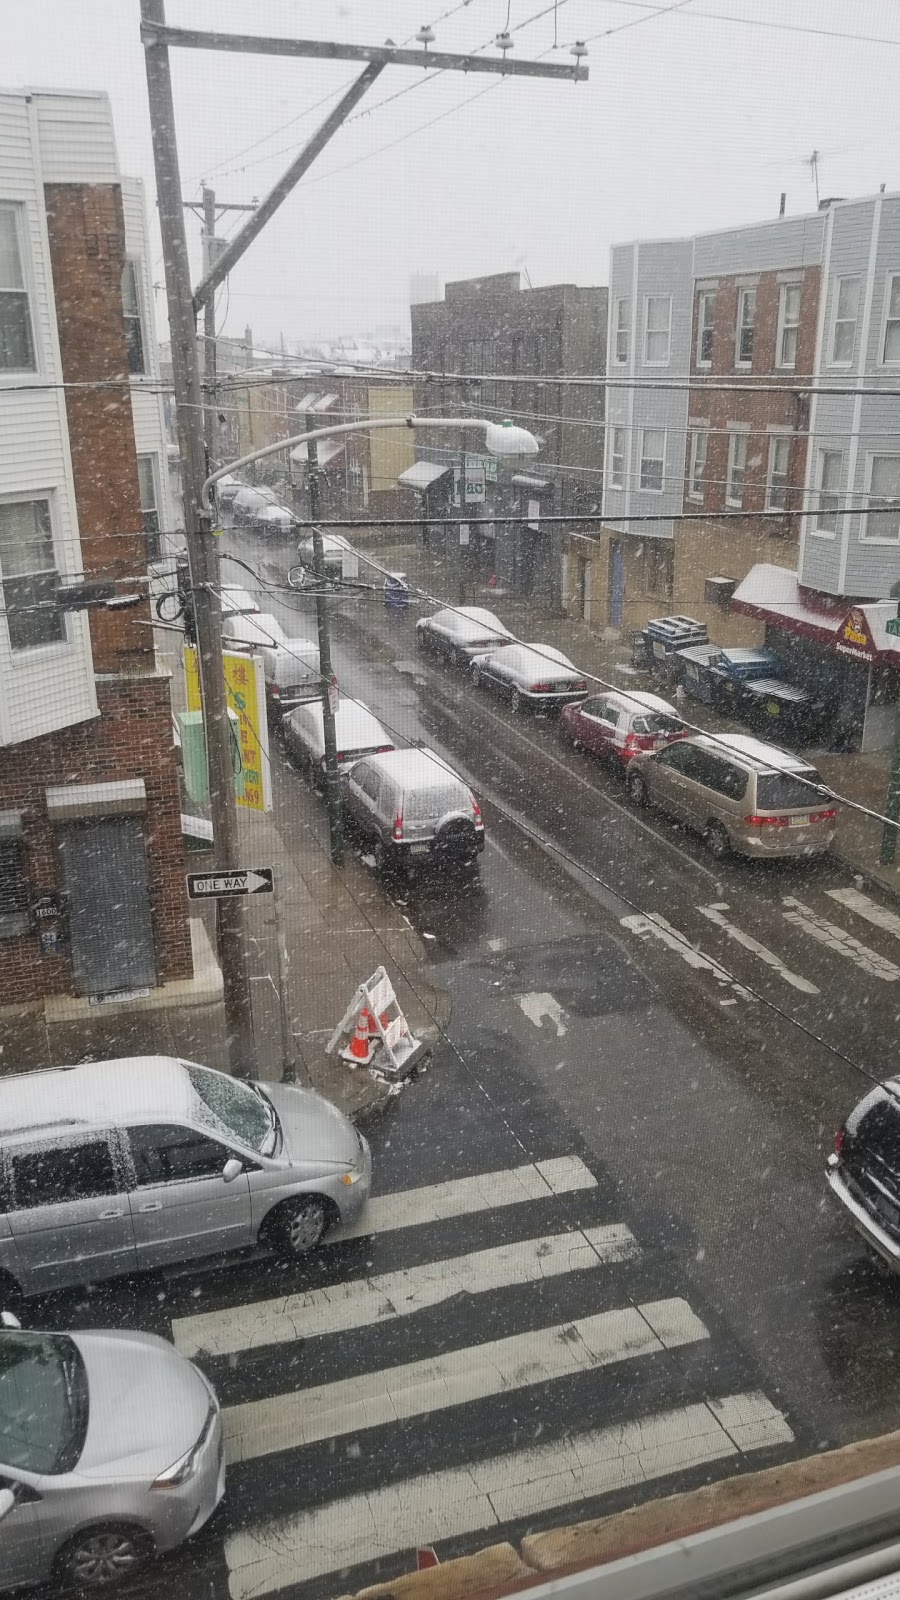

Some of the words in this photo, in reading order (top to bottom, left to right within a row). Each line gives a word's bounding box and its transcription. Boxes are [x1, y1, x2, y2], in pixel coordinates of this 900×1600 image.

[836, 642, 873, 661] SuperMarket
[197, 880, 221, 892] ONE
[224, 877, 248, 889] WAY
[36, 908, 58, 918] 1600
